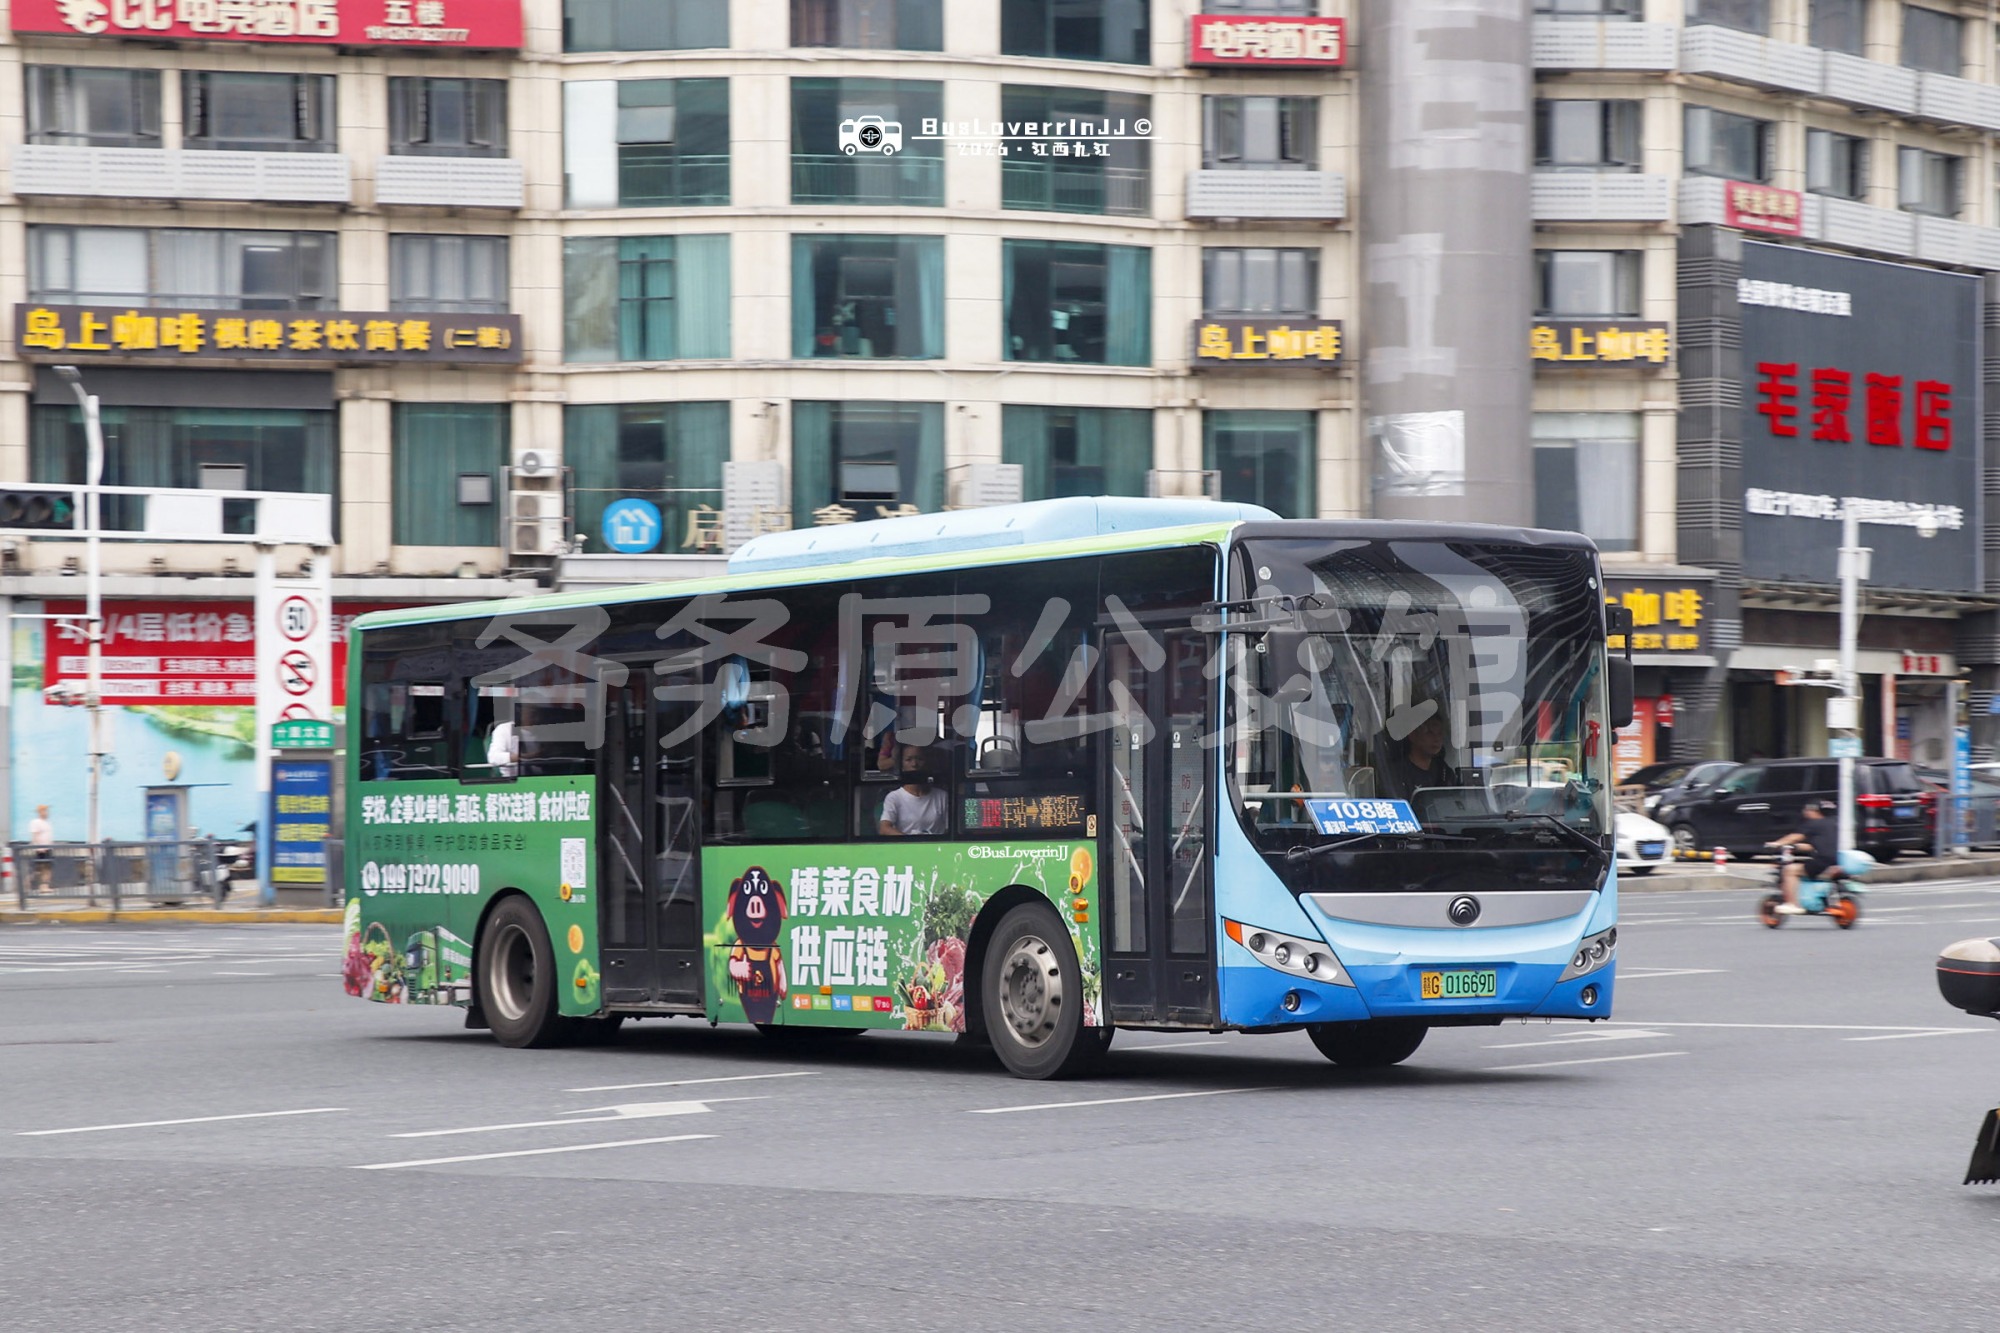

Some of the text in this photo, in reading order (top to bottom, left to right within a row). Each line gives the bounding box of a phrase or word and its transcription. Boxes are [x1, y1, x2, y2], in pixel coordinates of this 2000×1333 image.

[1199, 21, 1341, 60] 电竞酒店
[23, 308, 206, 353] 岛上咖啡
[363, 320, 432, 352] 简餐
[1197, 324, 1342, 360] 岛上咖啡
[1530, 326, 1671, 363] 岛上咖啡
[288, 606, 305, 630] 50
[538, 790, 590, 822] 食材供应
[1328, 802, 1399, 820] 108路
[791, 865, 913, 918] 博莱食材
[791, 925, 888, 987] 供应链
